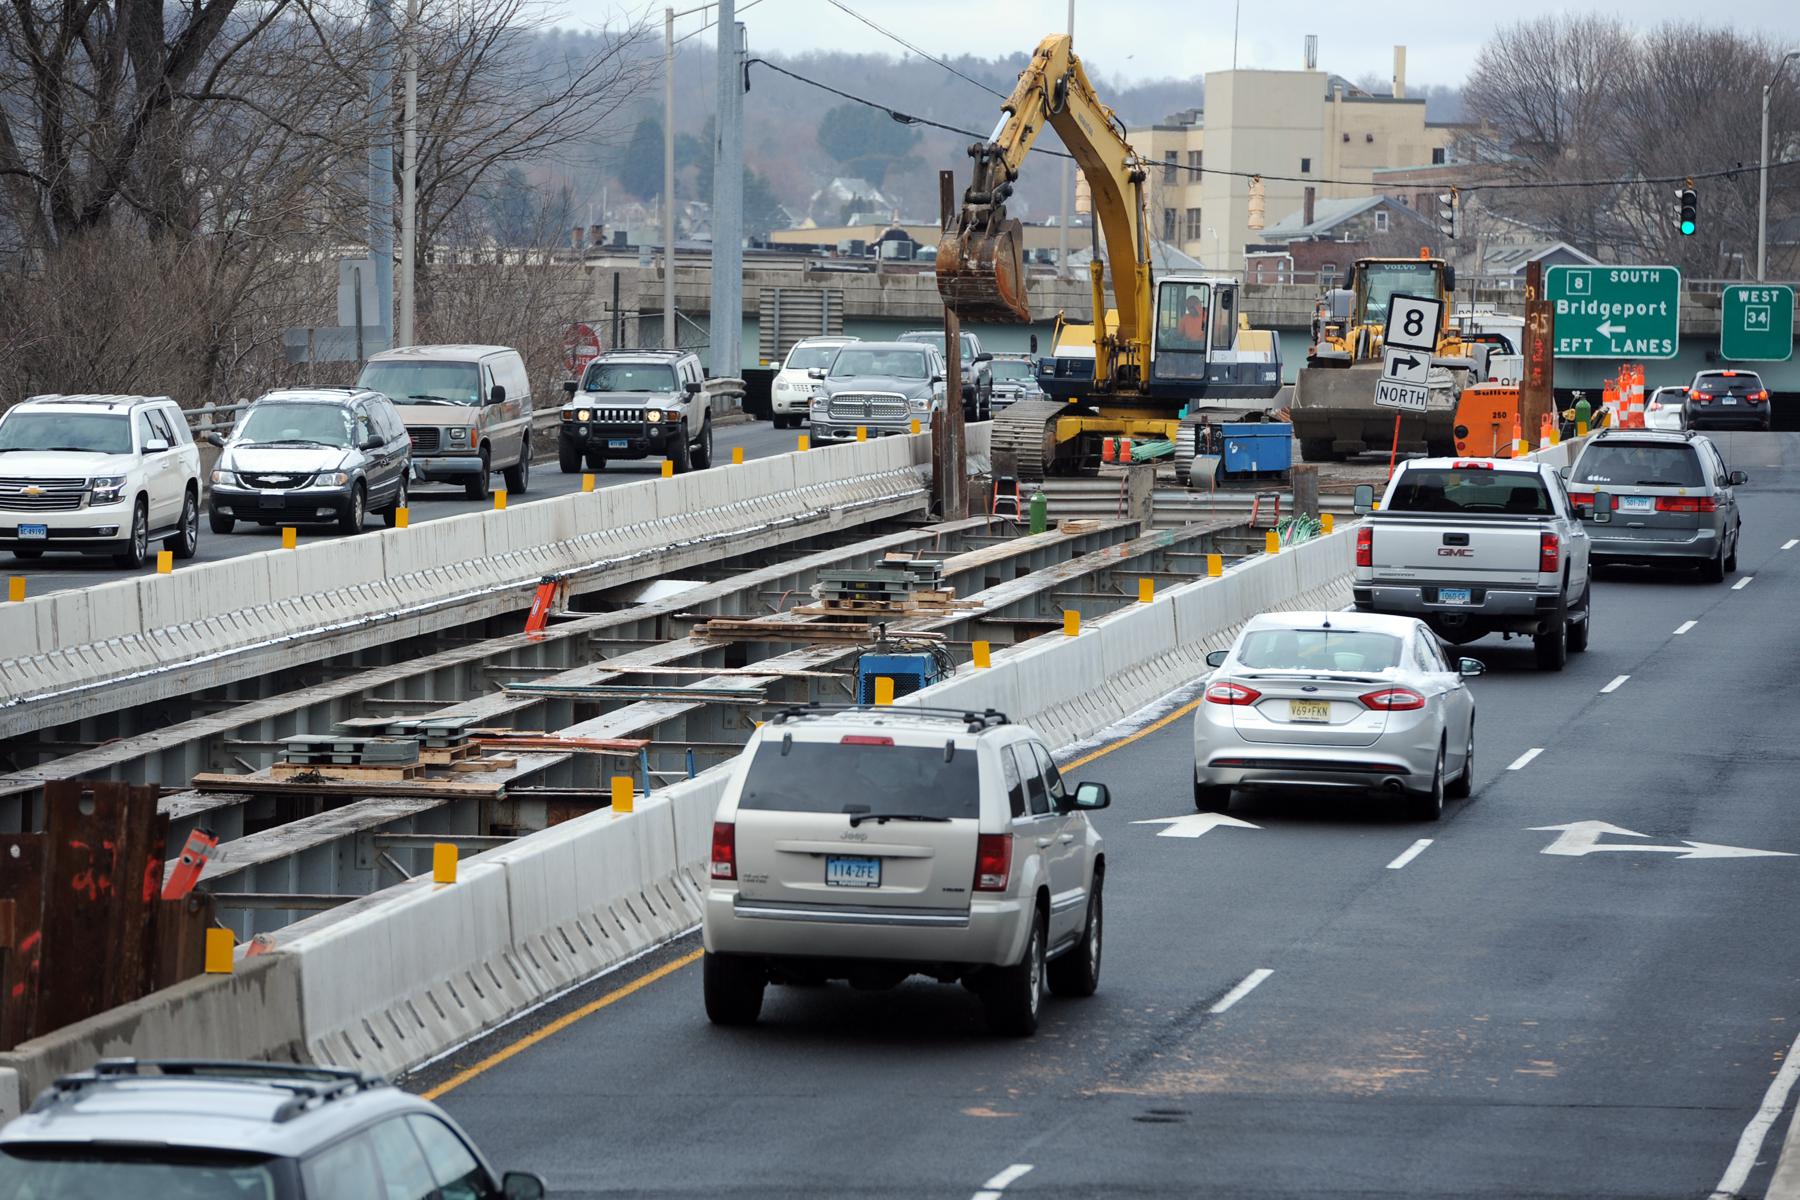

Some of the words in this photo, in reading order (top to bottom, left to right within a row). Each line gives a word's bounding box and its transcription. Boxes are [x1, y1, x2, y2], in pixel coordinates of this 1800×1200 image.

[1574, 277, 1583, 289] 8
[1610, 270, 1660, 283] SOUTH
[1739, 290, 1779, 303] WEST
[1556, 299, 1667, 320] Bridgeport
[1403, 309, 1424, 336] 8
[1748, 311, 1767, 324] 34
[1611, 338, 1672, 353] LANES
[1379, 386, 1426, 405] NORTH
[1492, 411, 1507, 419] 250
[1437, 548, 1474, 557] GMC
[1311, 706, 1328, 717] FKN
[840, 831, 868, 842] Jeep
